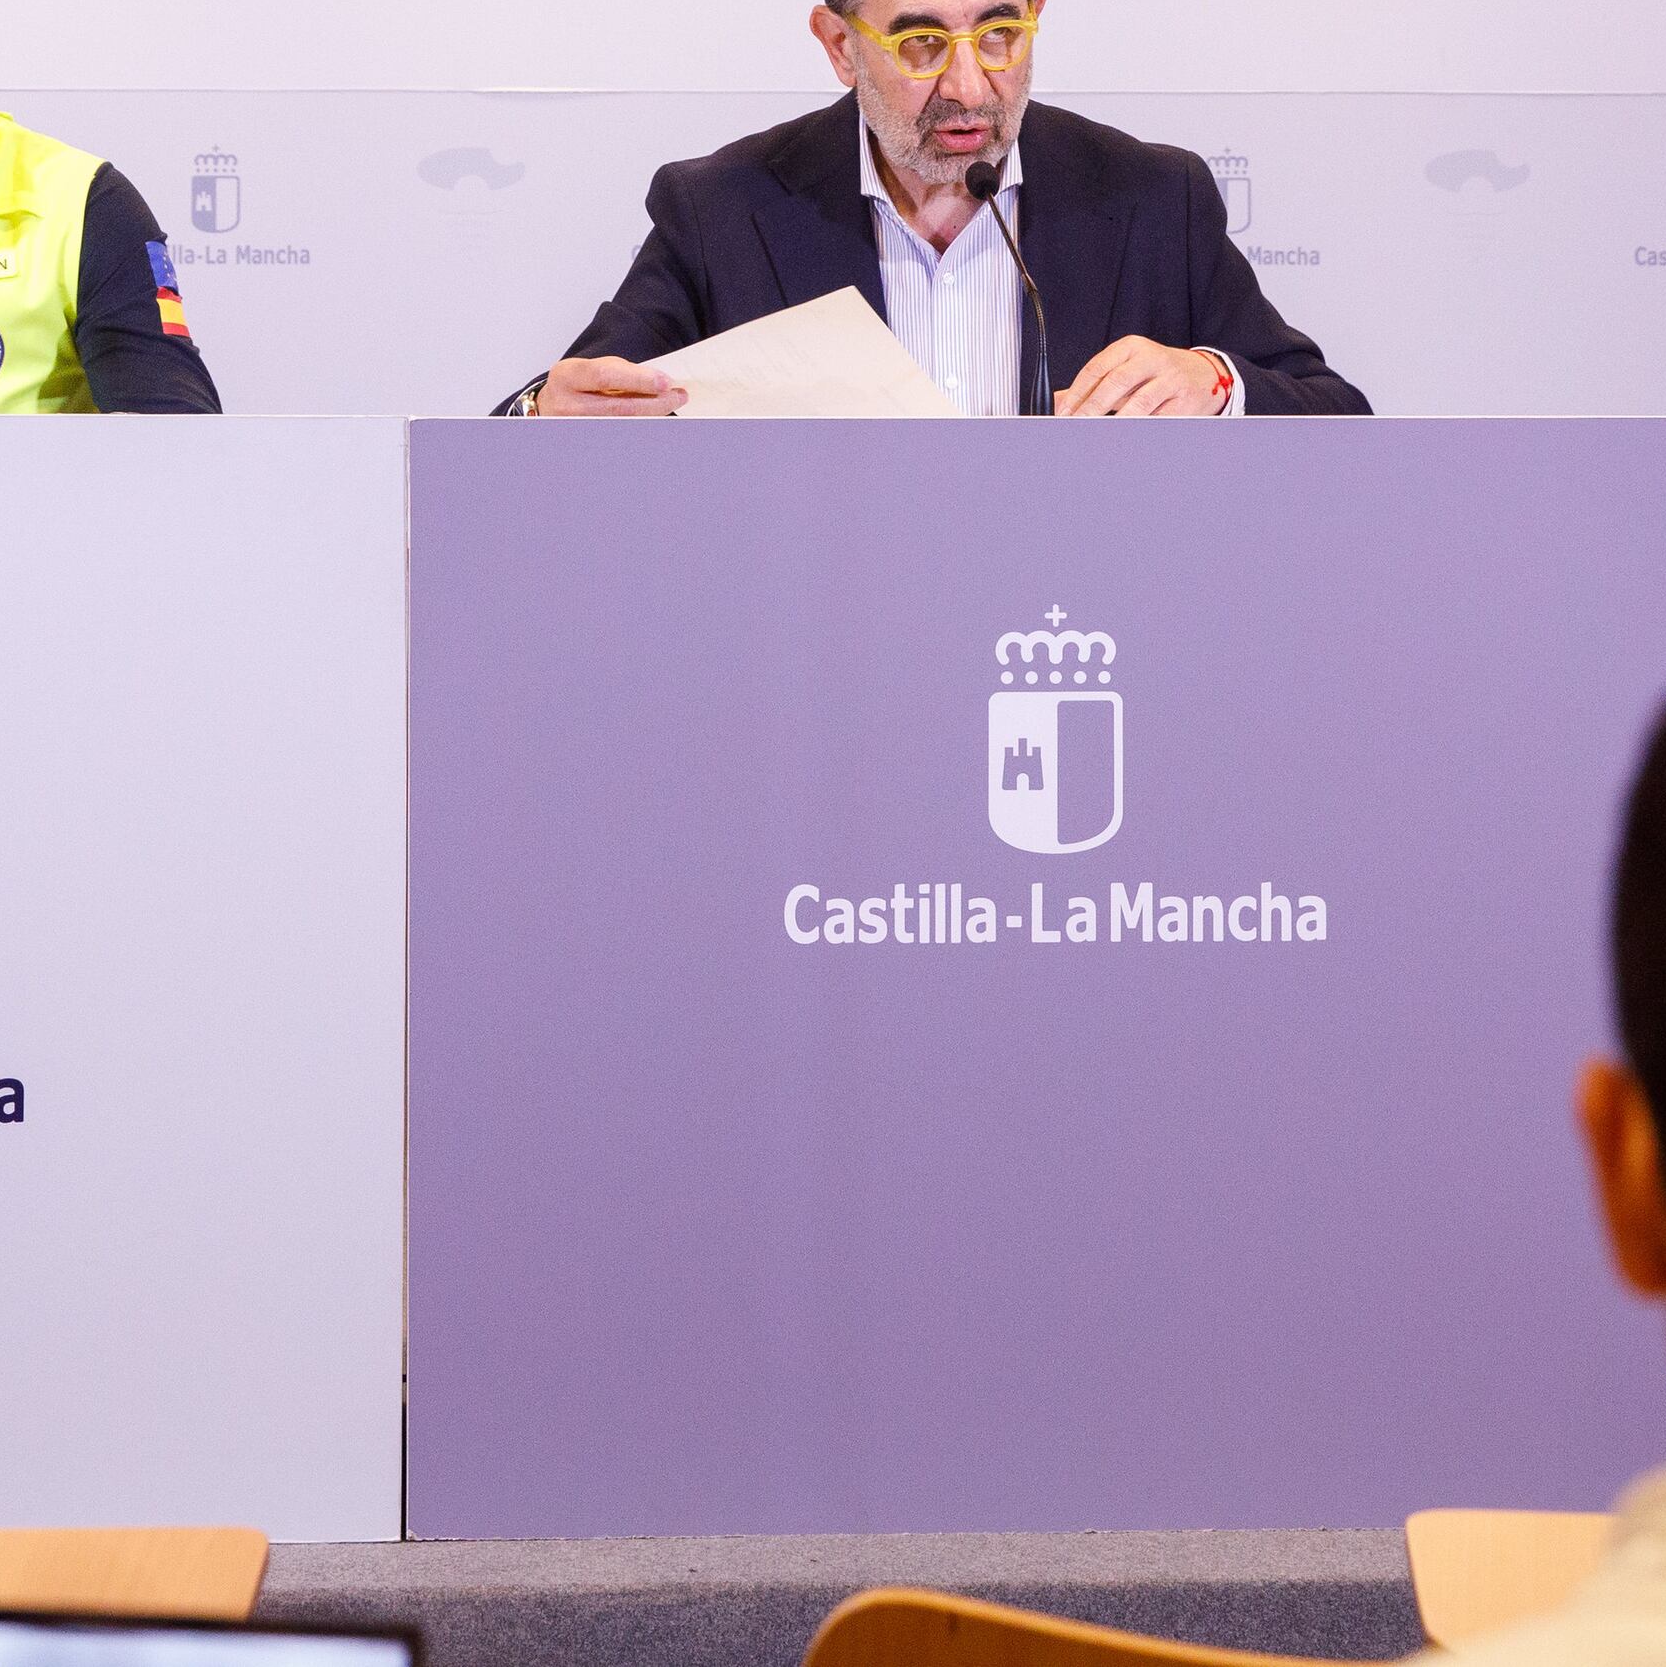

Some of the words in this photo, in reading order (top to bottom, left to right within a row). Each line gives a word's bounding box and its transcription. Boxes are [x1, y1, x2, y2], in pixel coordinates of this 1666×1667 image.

[236, 244, 311, 265] Mancha
[1245, 245, 1320, 265] Mancha
[784, 883, 1096, 944] Castilla-La
[1110, 882, 1327, 942] Mancha
